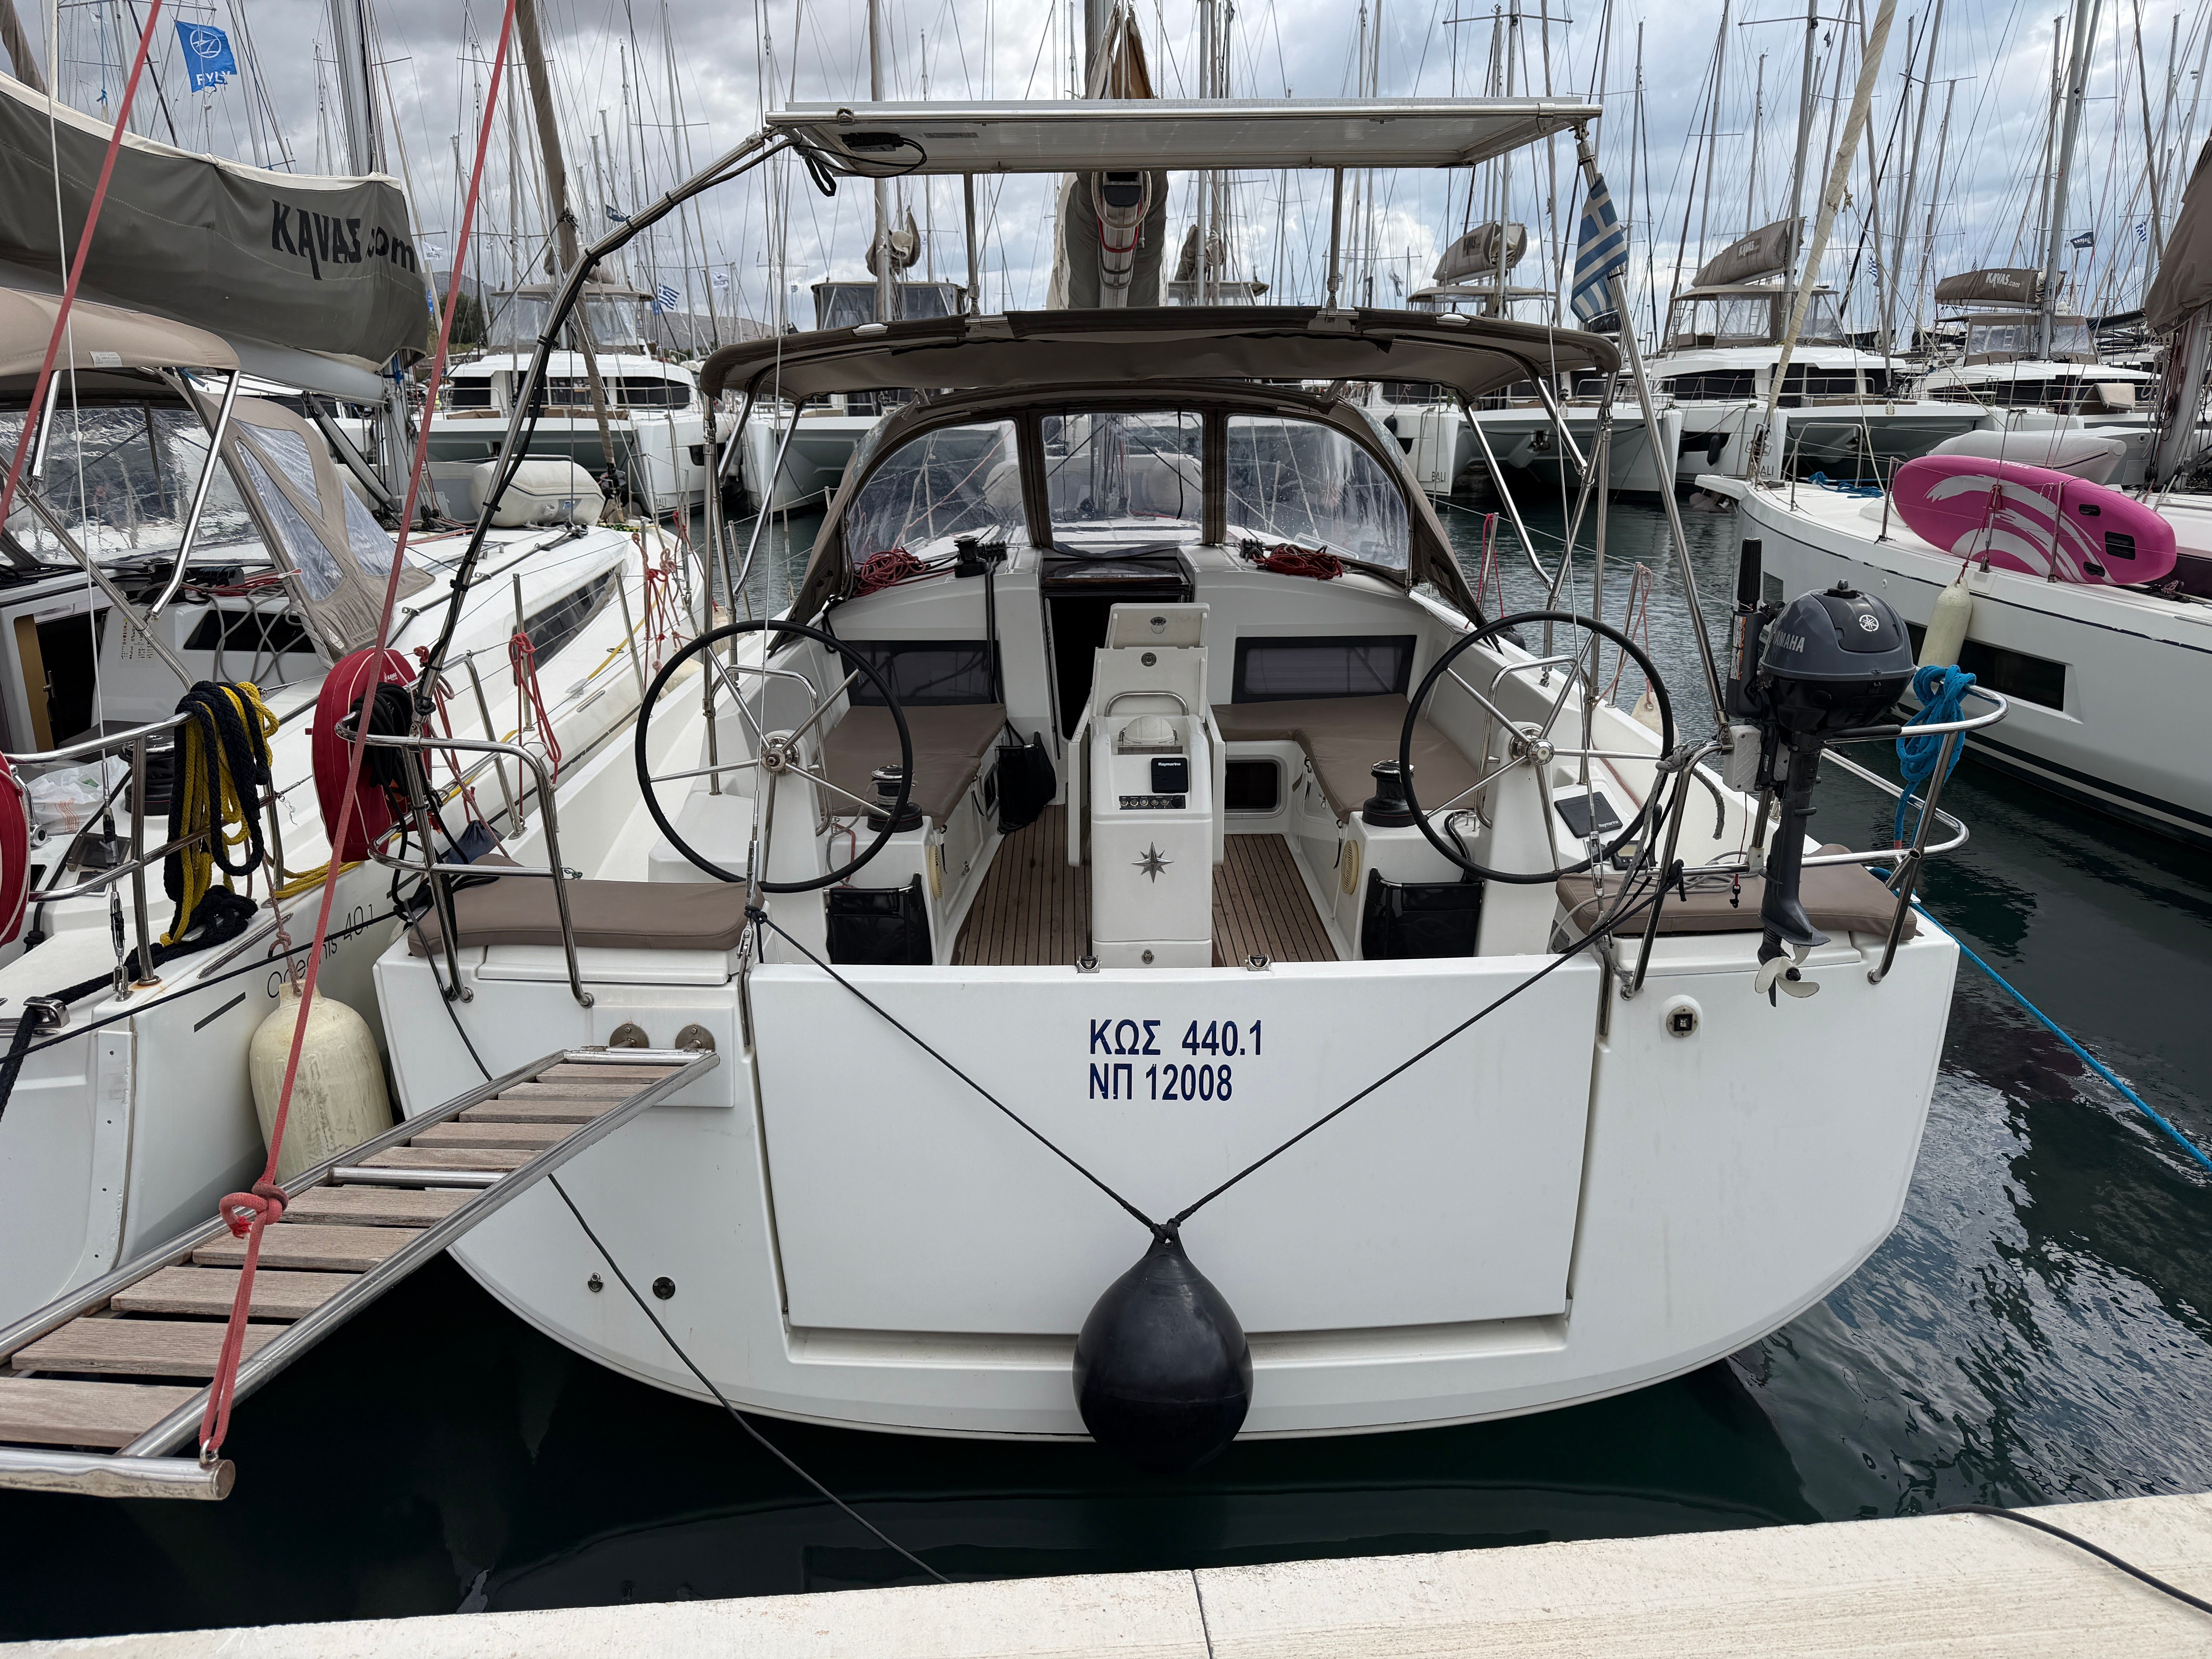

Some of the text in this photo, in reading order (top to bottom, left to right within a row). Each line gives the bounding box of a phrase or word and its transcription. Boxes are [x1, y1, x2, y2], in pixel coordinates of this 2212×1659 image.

[1985, 272, 2020, 288] KAVAS.com
[1432, 471, 1446, 483] BALI
[1760, 465, 1774, 476] ALI
[1772, 630, 1805, 653] YAMAHA
[267, 934, 337, 998] Oenis
[1090, 1019, 1261, 1056] ΚΩΣ 440.1
[1089, 1063, 1232, 1101] ΝΠ 12008
